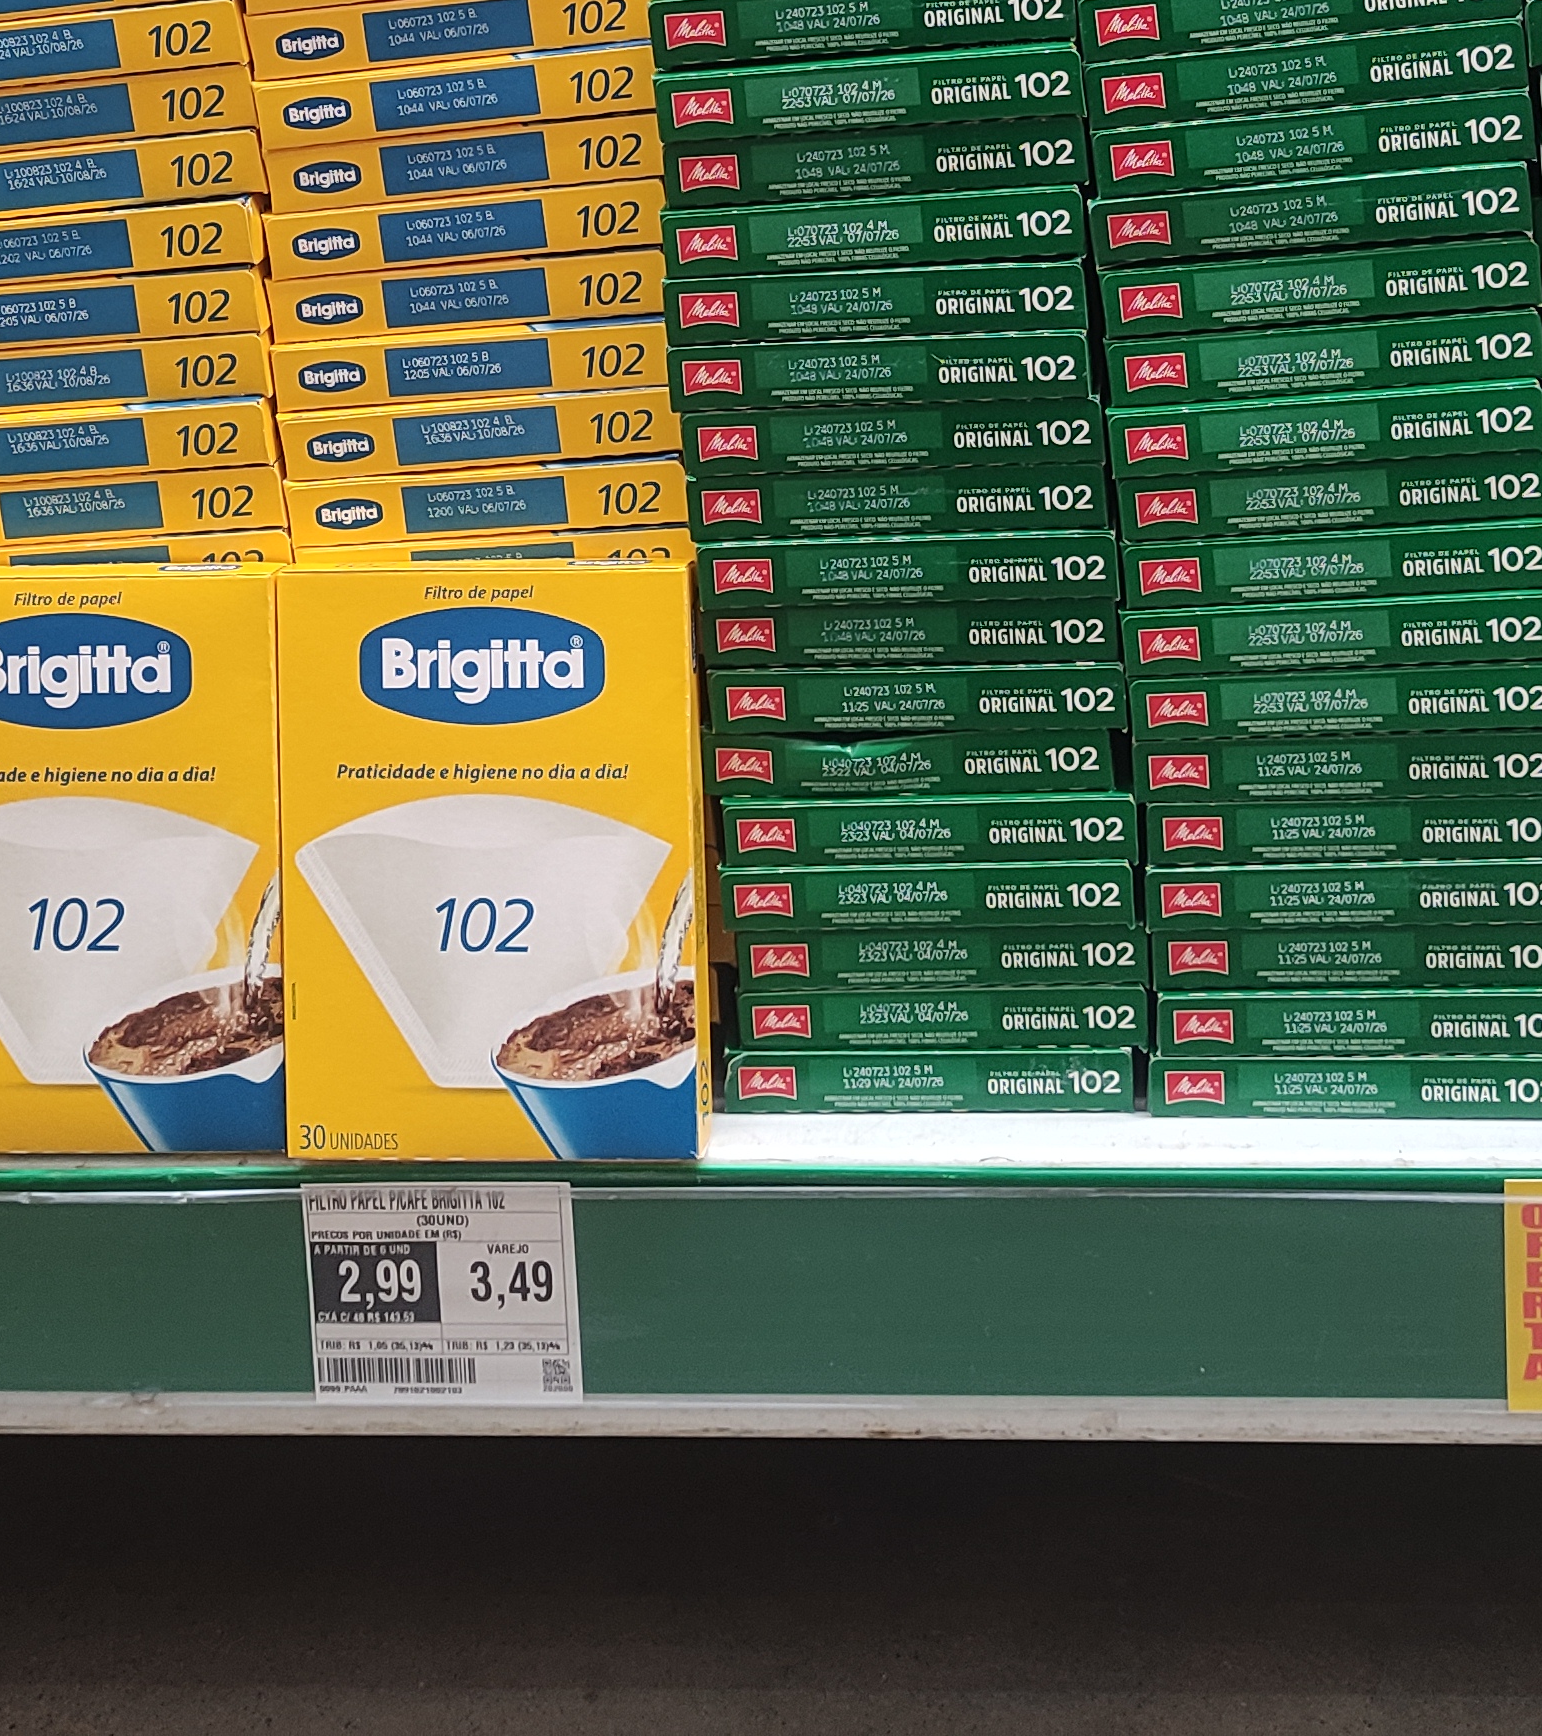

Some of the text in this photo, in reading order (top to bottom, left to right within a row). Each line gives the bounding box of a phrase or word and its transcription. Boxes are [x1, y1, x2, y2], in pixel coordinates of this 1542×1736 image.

[923, 5, 1005, 28] ORIGINAL
[381, 636, 585, 706] Brigitta
[435, 898, 537, 953] 102
[487, 1244, 529, 1254] VAREJO
[339, 1259, 422, 1309] 2,99
[469, 1261, 553, 1309] 3,49
